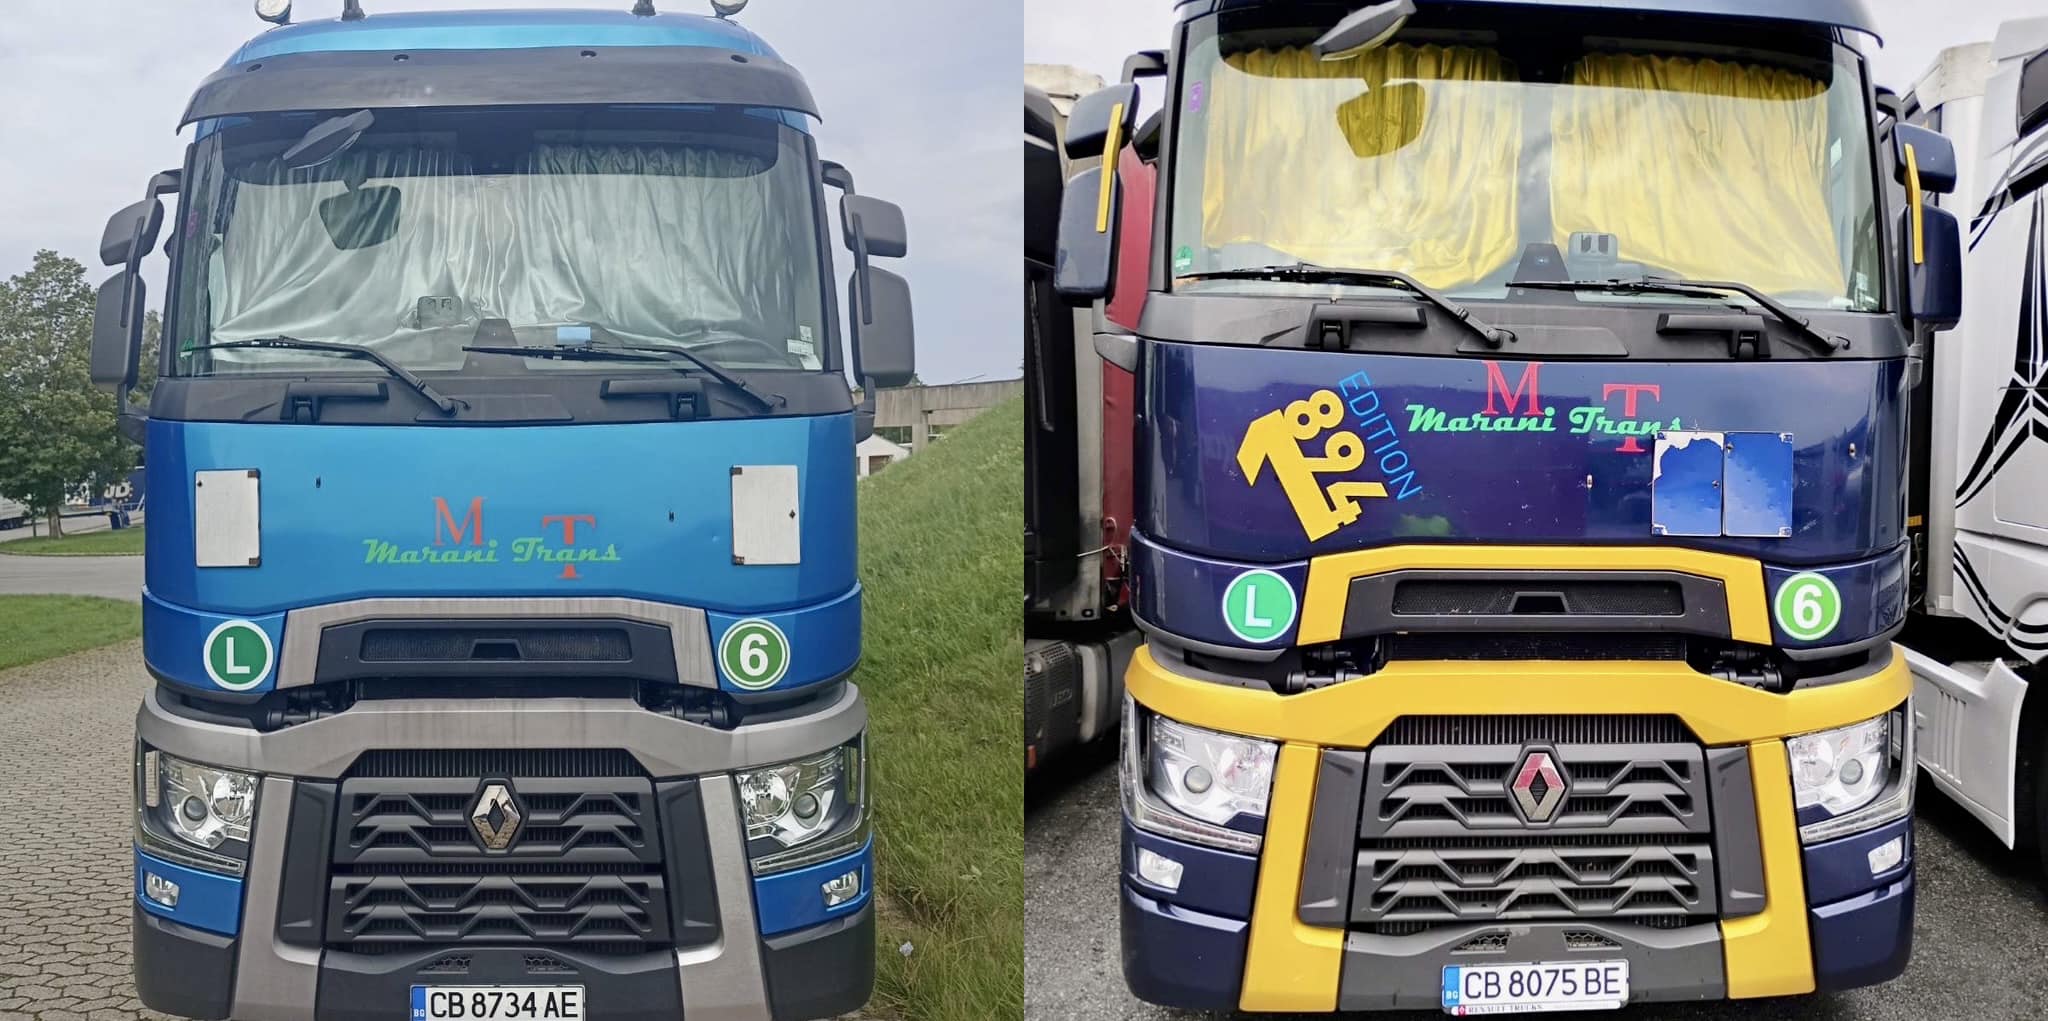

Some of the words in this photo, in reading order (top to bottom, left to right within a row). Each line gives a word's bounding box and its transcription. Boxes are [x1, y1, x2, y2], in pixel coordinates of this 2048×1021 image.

[1405, 404, 1557, 432] Marani
[1568, 406, 1681, 434] Trans
[1481, 360, 1544, 416] M
[1602, 383, 1660, 452] T
[1338, 369, 1424, 501] EDITION
[362, 538, 499, 564] Marani
[511, 536, 621, 562] Trans
[432, 495, 487, 546] M
[541, 513, 596, 578] T
[1245, 584, 1273, 628] L
[1791, 583, 1824, 629] 6
[226, 636, 250, 674] L
[738, 632, 770, 677] 6
[413, 1008, 426, 1017] BG
[430, 991, 466, 1018] CB
[471, 991, 537, 1018] 8734
[543, 991, 578, 1018] AE
[1445, 990, 1459, 999] BG
[1464, 971, 1501, 999] CB
[1508, 968, 1578, 998] 8075
[1584, 967, 1621, 995] BE
